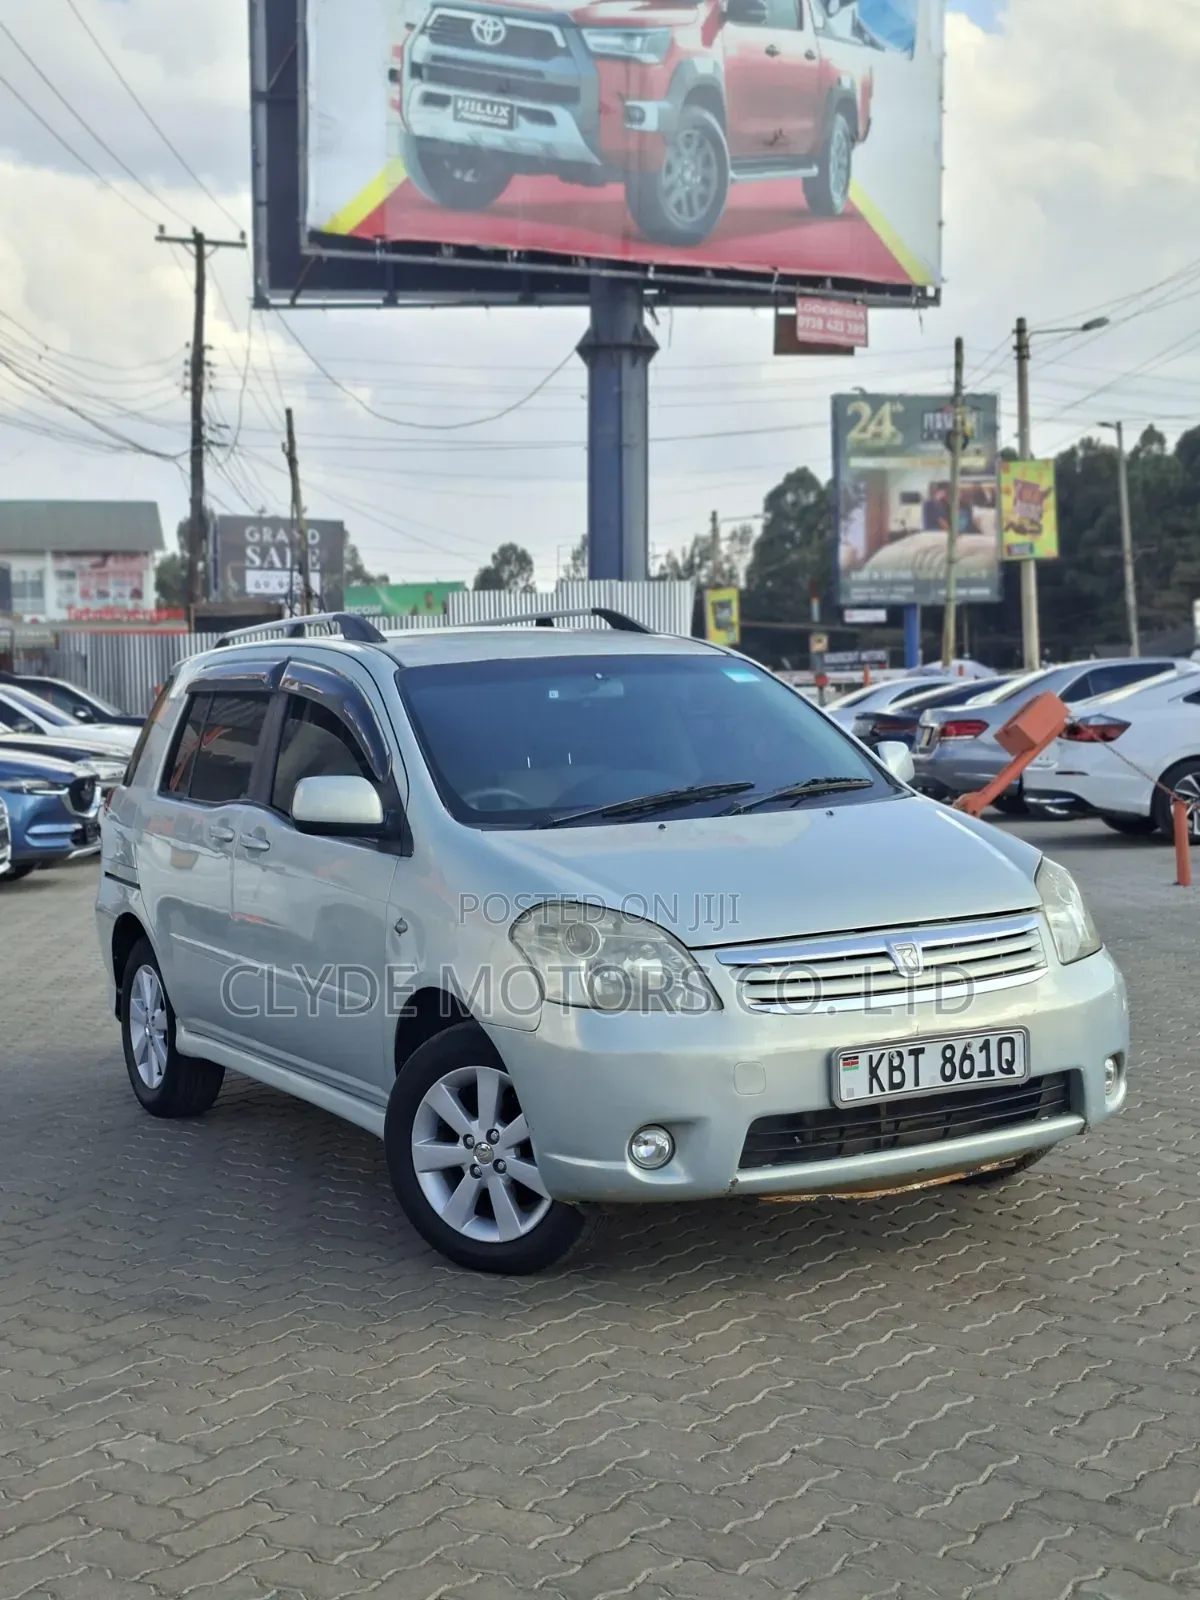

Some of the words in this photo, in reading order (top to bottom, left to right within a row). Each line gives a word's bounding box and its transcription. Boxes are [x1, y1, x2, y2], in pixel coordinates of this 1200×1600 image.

[457, 100, 510, 117] HILUX
[868, 1047, 925, 1094] KBT
[940, 1036, 1016, 1083] 861Q
